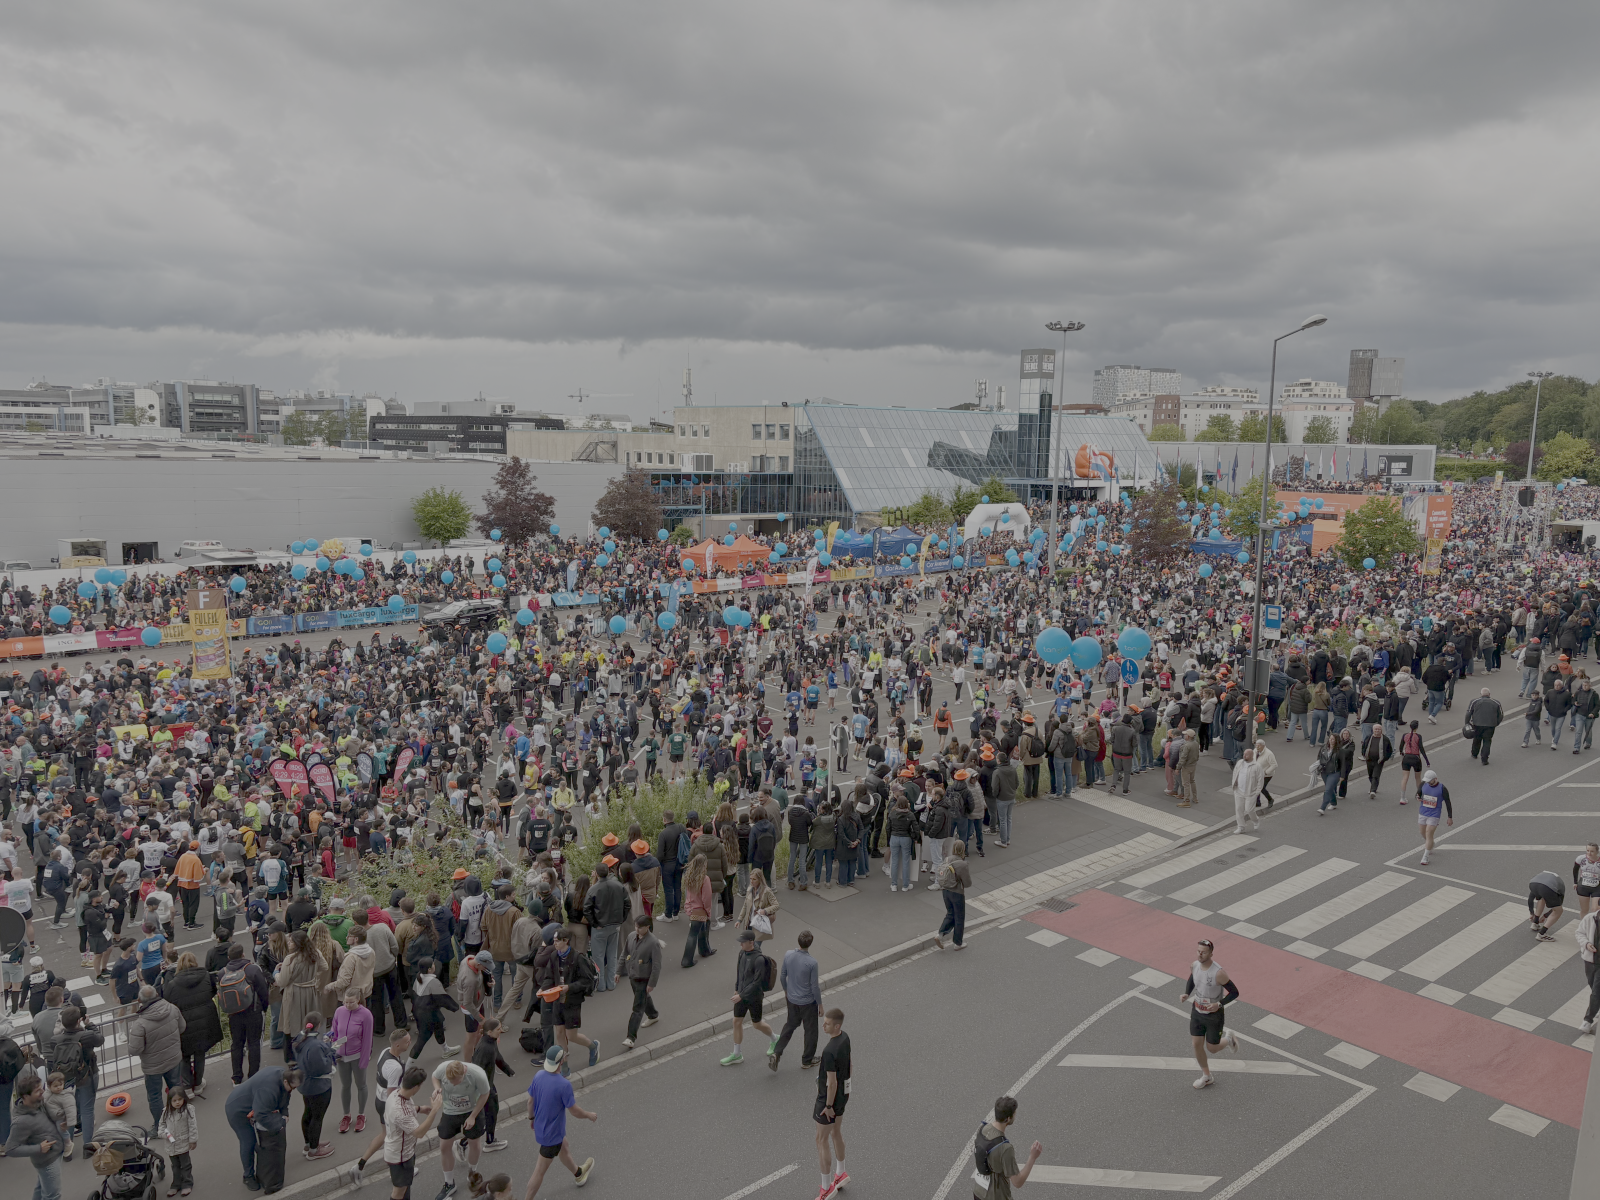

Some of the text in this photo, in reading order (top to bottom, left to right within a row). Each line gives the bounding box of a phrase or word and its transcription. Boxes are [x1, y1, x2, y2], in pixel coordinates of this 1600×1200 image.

[748, 524, 754, 534] C
[1433, 529, 1440, 538] E
[199, 592, 209, 609] F
[194, 612, 219, 625] FULFIL
[340, 610, 376, 619] luxcargo
